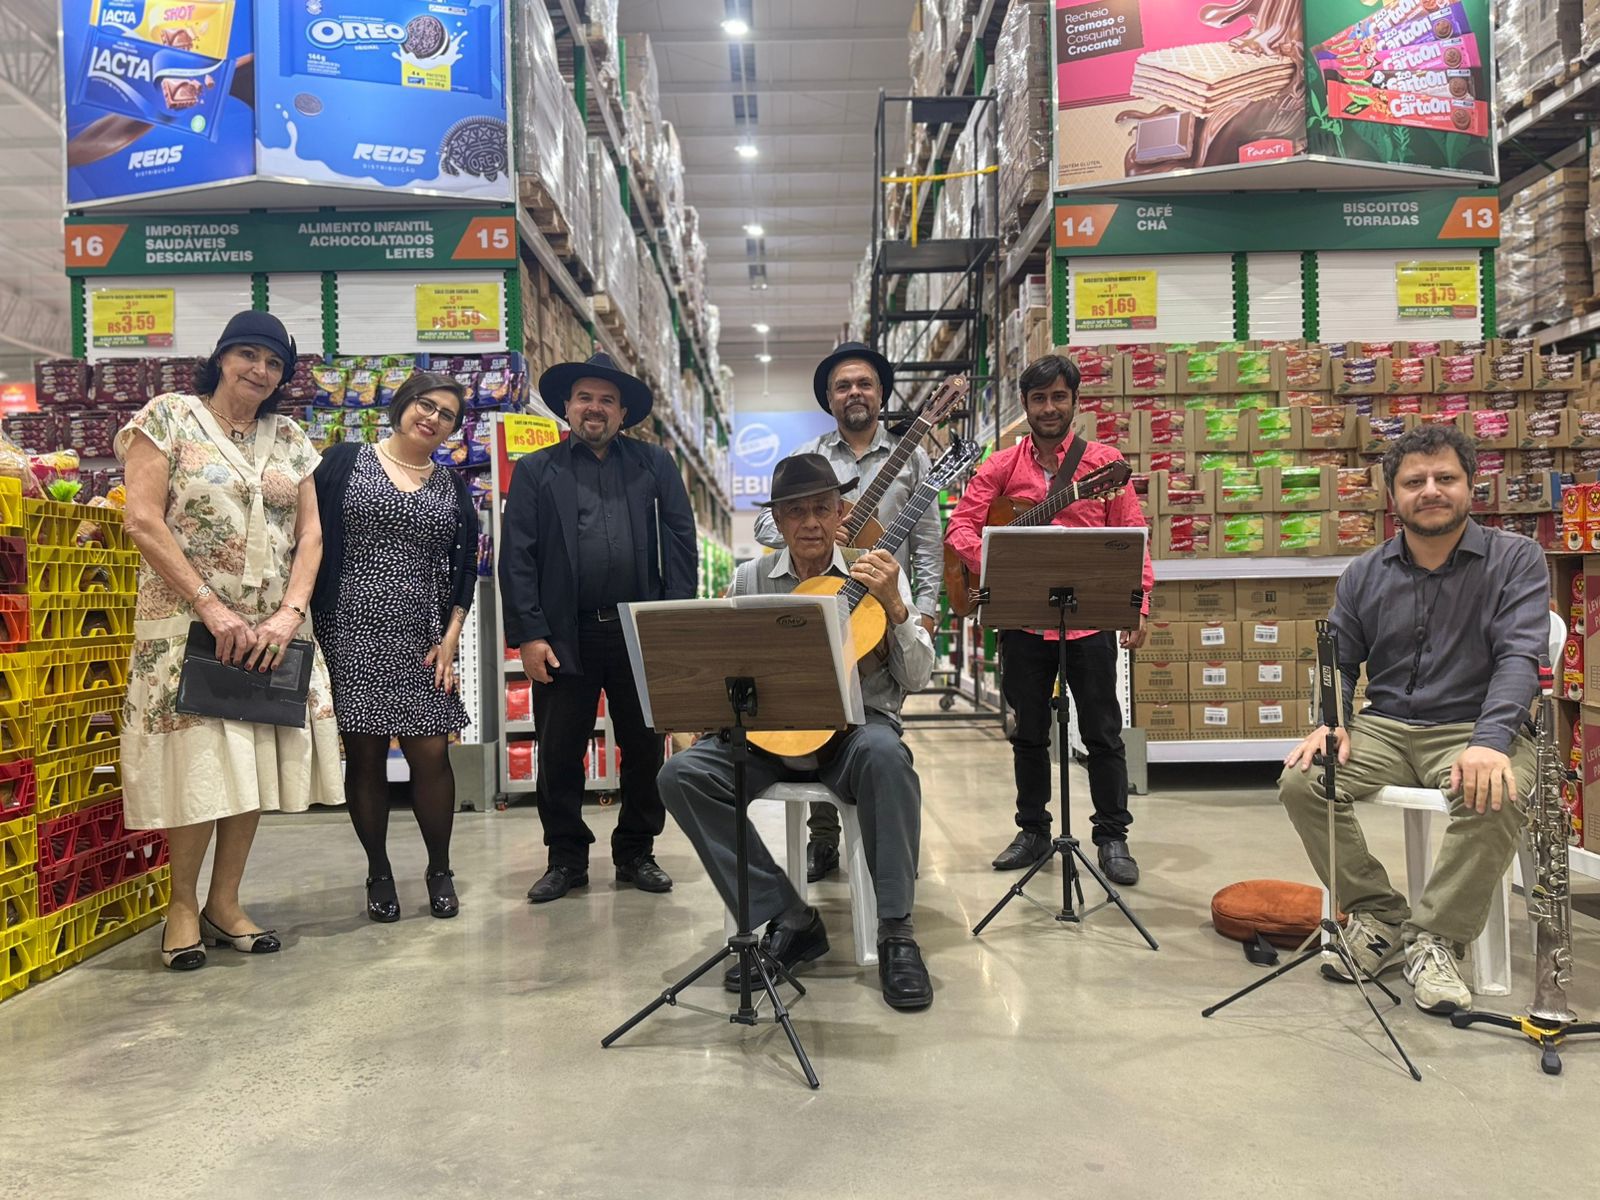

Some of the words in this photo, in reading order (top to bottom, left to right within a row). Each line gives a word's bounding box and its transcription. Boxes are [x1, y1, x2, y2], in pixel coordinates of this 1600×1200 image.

[102, 9, 136, 26] LACTA
[163, 5, 196, 21] SHOT
[1065, 8, 1108, 24] Recheio
[310, 20, 405, 44] OREO
[1066, 18, 1114, 34] Cremoso
[1067, 26, 1126, 44] Casquinha
[1068, 36, 1122, 55] Crocante!
[1390, 50, 1407, 60] Zoo
[88, 46, 150, 82] LACTA
[1395, 71, 1412, 81] Zoo
[1401, 94, 1416, 103] Zoo
[128, 145, 184, 170] REDS
[353, 143, 426, 165] REDS
[1247, 144, 1284, 156] Parati
[470, 153, 500, 170] OREO
[1136, 204, 1172, 216] CAFÉ
[1344, 202, 1418, 213] BISCOITOS
[1136, 218, 1168, 230] CHÁ
[1344, 215, 1419, 226] TORRADAS
[1462, 208, 1492, 228] 13
[146, 224, 240, 236] IMPORTADOS
[298, 222, 370, 234] ALIMENTO
[374, 220, 433, 232] INFANTIL
[1062, 216, 1094, 237] 14
[71, 236, 104, 256] 16
[146, 235, 226, 250] SAUDÁVEIS
[310, 234, 434, 247] ACHOCOLATADOS
[477, 228, 509, 249] 15
[146, 250, 254, 263] DESCARTÁVEIS
[386, 248, 434, 259] LEITES
[732, 476, 769, 494] EBI
